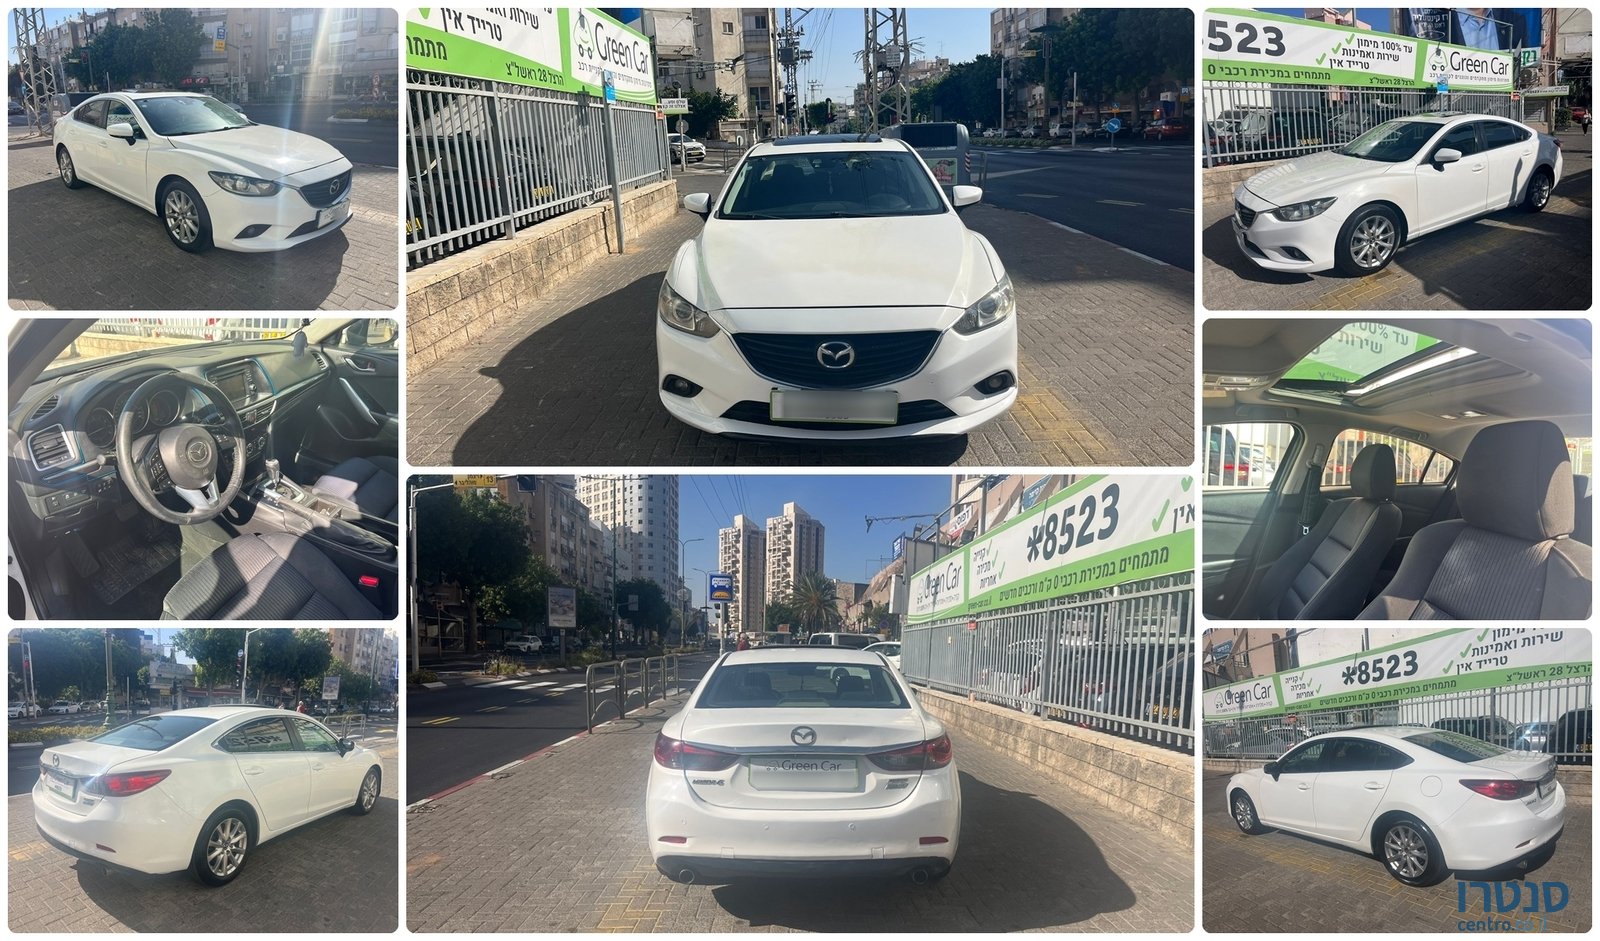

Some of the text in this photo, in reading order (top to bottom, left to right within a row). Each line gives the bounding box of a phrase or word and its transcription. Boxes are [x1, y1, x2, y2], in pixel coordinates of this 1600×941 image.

[441, 8, 503, 42] טרייד אין
[1208, 19, 1286, 57] 523
[1357, 38, 1413, 54] עד 100% מימון
[595, 22, 649, 75] Green Car
[1342, 48, 1400, 62] שירות ואמינות
[1208, 64, 1331, 80] מתמחים במכירת רכבי 0
[1329, 58, 1370, 70] טרייד אין
[1450, 52, 1509, 76] Green Car
[538, 69, 548, 83] 28
[549, 70, 565, 86] הרצל
[1392, 331, 1409, 346] עד
[1173, 502, 1195, 534] אין
[1119, 546, 1169, 572] מתמחים
[946, 562, 962, 591] Car
[1061, 572, 1078, 587] רכבי
[1080, 562, 1116, 584] במכירת
[1054, 575, 1059, 590] 0
[1471, 631, 1564, 658] שירות ואמינות
[1456, 655, 1508, 675] טרייד אין
[1550, 666, 1564, 677] 28
[1376, 689, 1392, 699] רכבי
[1393, 686, 1421, 697] במכירת
[1423, 680, 1457, 692] מתמחים
[1225, 683, 1272, 706] Green Car
[782, 760, 842, 771] Green Car
